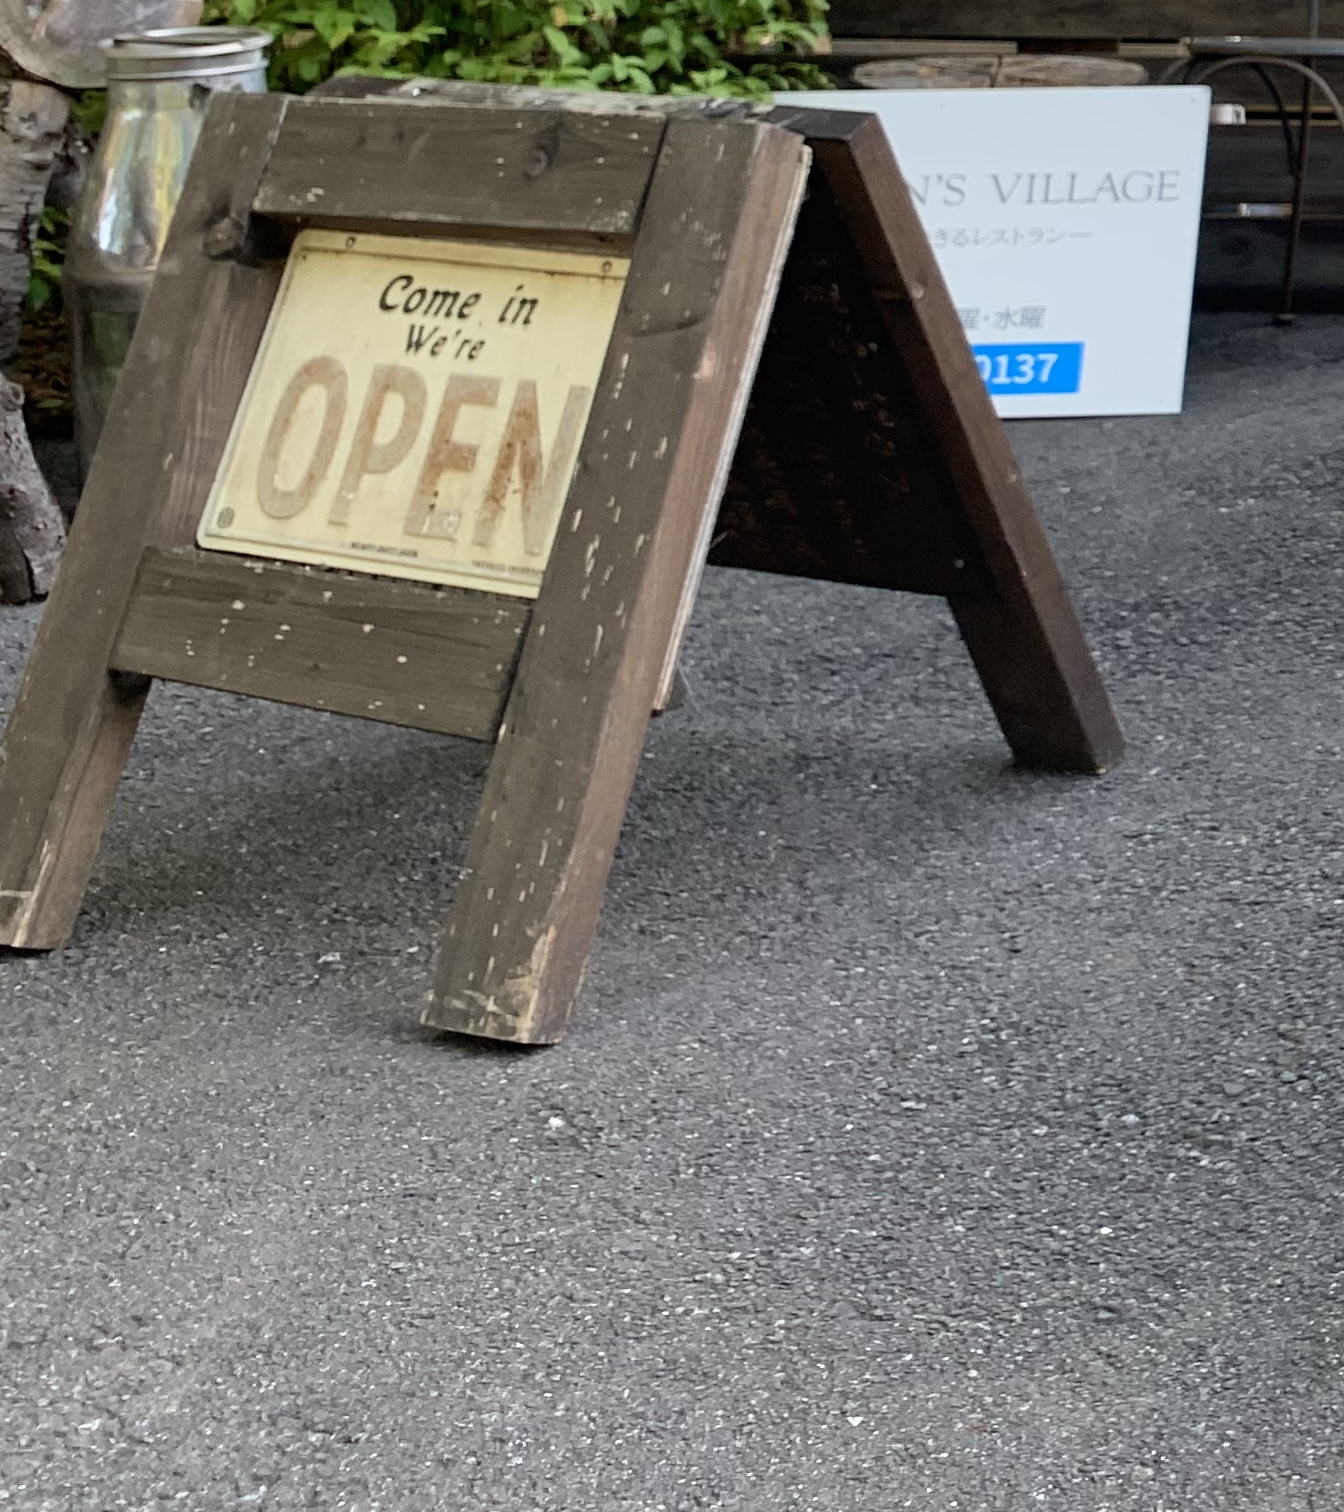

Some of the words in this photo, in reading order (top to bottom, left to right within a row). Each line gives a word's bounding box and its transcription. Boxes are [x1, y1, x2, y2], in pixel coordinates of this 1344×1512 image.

[990, 169, 1182, 206] VILLAGE
[378, 274, 478, 325] Come
[497, 284, 541, 328] in
[403, 323, 487, 362] We're
[256, 355, 593, 557] OPEN
